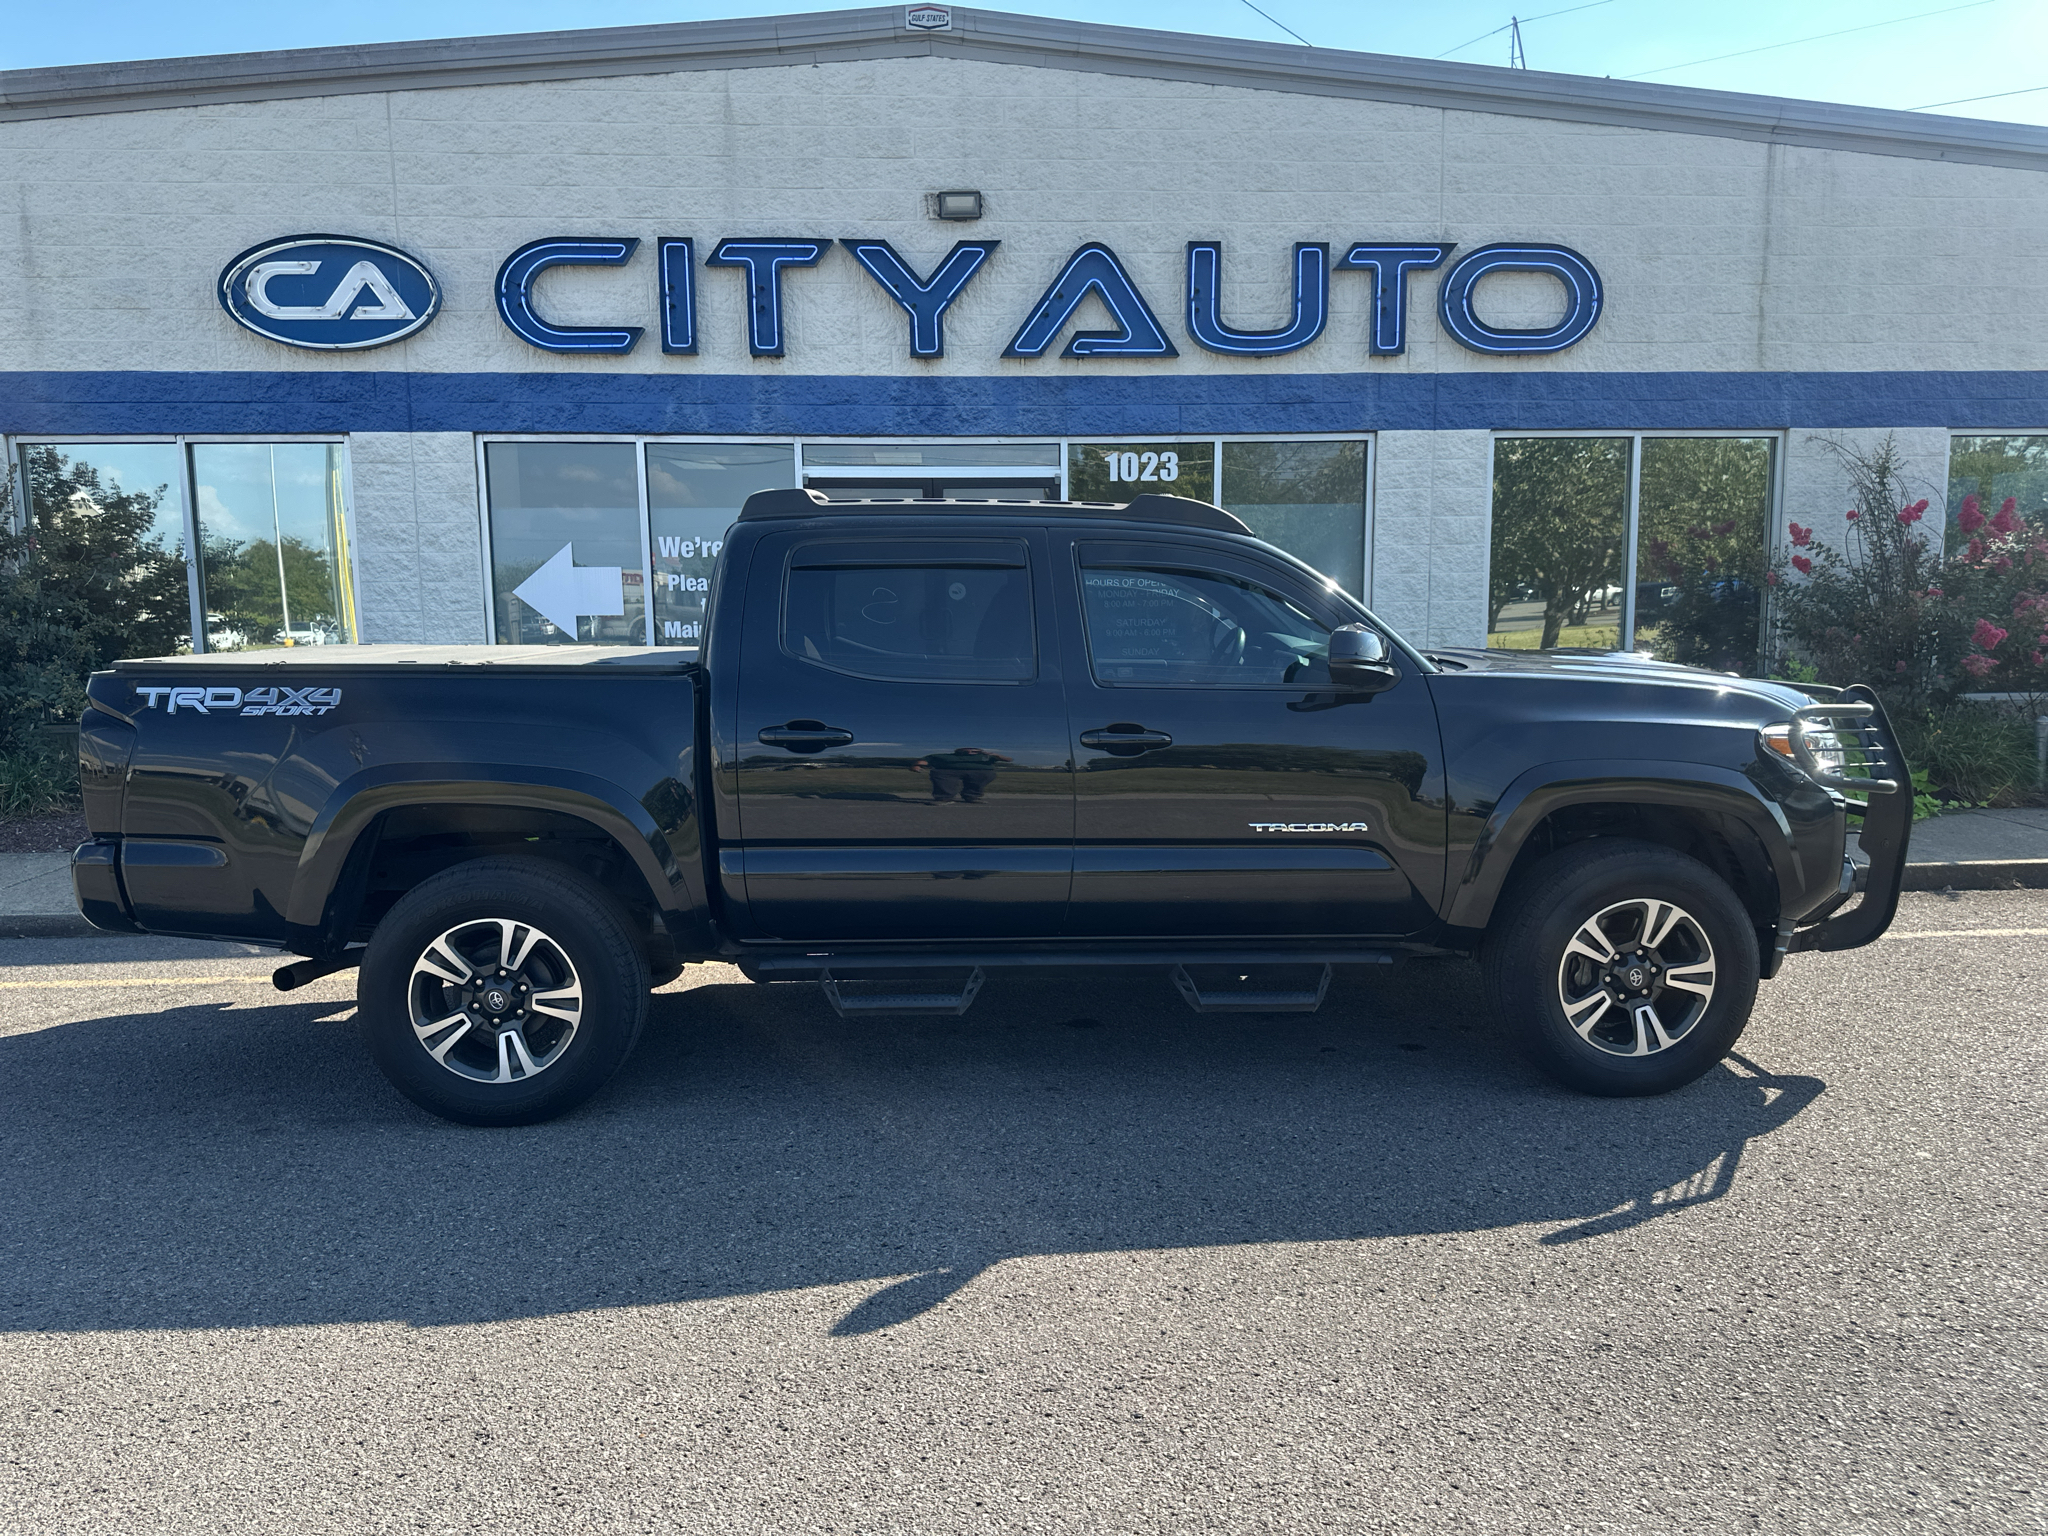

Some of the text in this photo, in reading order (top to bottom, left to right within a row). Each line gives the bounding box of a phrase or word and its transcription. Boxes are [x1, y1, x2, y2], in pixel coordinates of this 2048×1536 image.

[911, 14, 946, 22] GULF STATES
[245, 260, 417, 320] CA
[494, 236, 1604, 358] CITY AUTO
[1104, 451, 1179, 481] 1023
[667, 574, 711, 591] Plea
[1085, 578, 1120, 587] HOURS
[1122, 578, 1136, 587] OF
[1098, 590, 1138, 598] MONDAY
[1146, 589, 1180, 598] FRIDAY
[1104, 600, 1121, 608] 8:00
[1122, 600, 1135, 608] AM
[664, 620, 702, 638] Mai
[1116, 618, 1166, 627] SATURDAY
[1124, 629, 1137, 637] AM
[1121, 647, 1160, 656] SUNDAY
[136, 686, 244, 715] TRD
[239, 704, 337, 717] SPORT
[1247, 822, 1369, 832] TACOMA
[409, 889, 548, 925] YOKOHAMA
[402, 1045, 601, 1117] GEOLANDAR H/T
